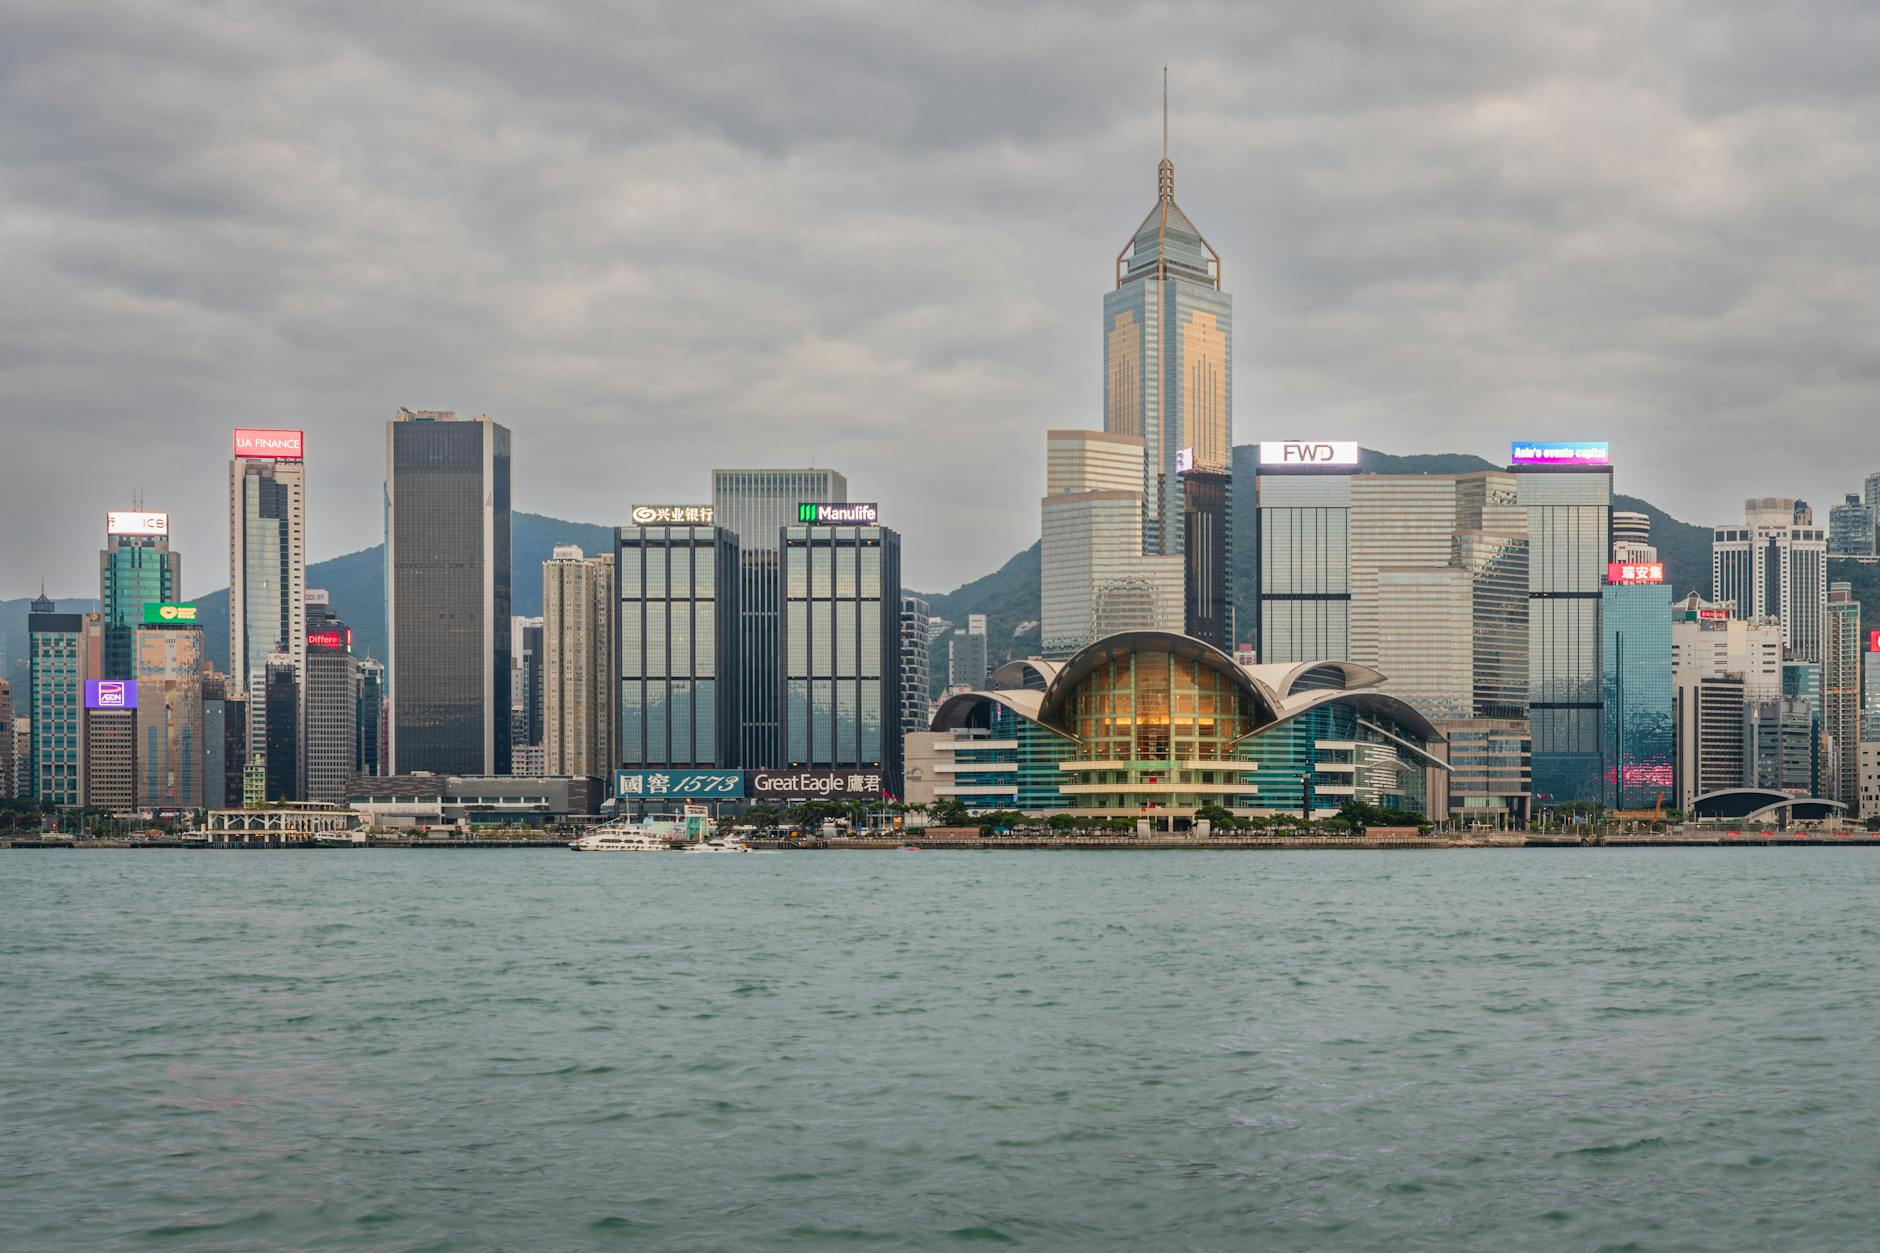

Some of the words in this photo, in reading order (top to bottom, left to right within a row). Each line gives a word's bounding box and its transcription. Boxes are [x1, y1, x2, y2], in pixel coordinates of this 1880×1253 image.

[237, 438, 252, 448] UA
[255, 438, 300, 449] FINANCE
[1283, 444, 1334, 461] FWD
[656, 507, 714, 522] 兴业银行
[818, 505, 876, 520] Manulife
[143, 518, 167, 528] ICB
[620, 773, 671, 795] 國窖
[672, 775, 739, 792] 1573
[754, 773, 799, 791] Great
[800, 773, 844, 795] Eagle
[846, 774, 881, 792] 鷹君
